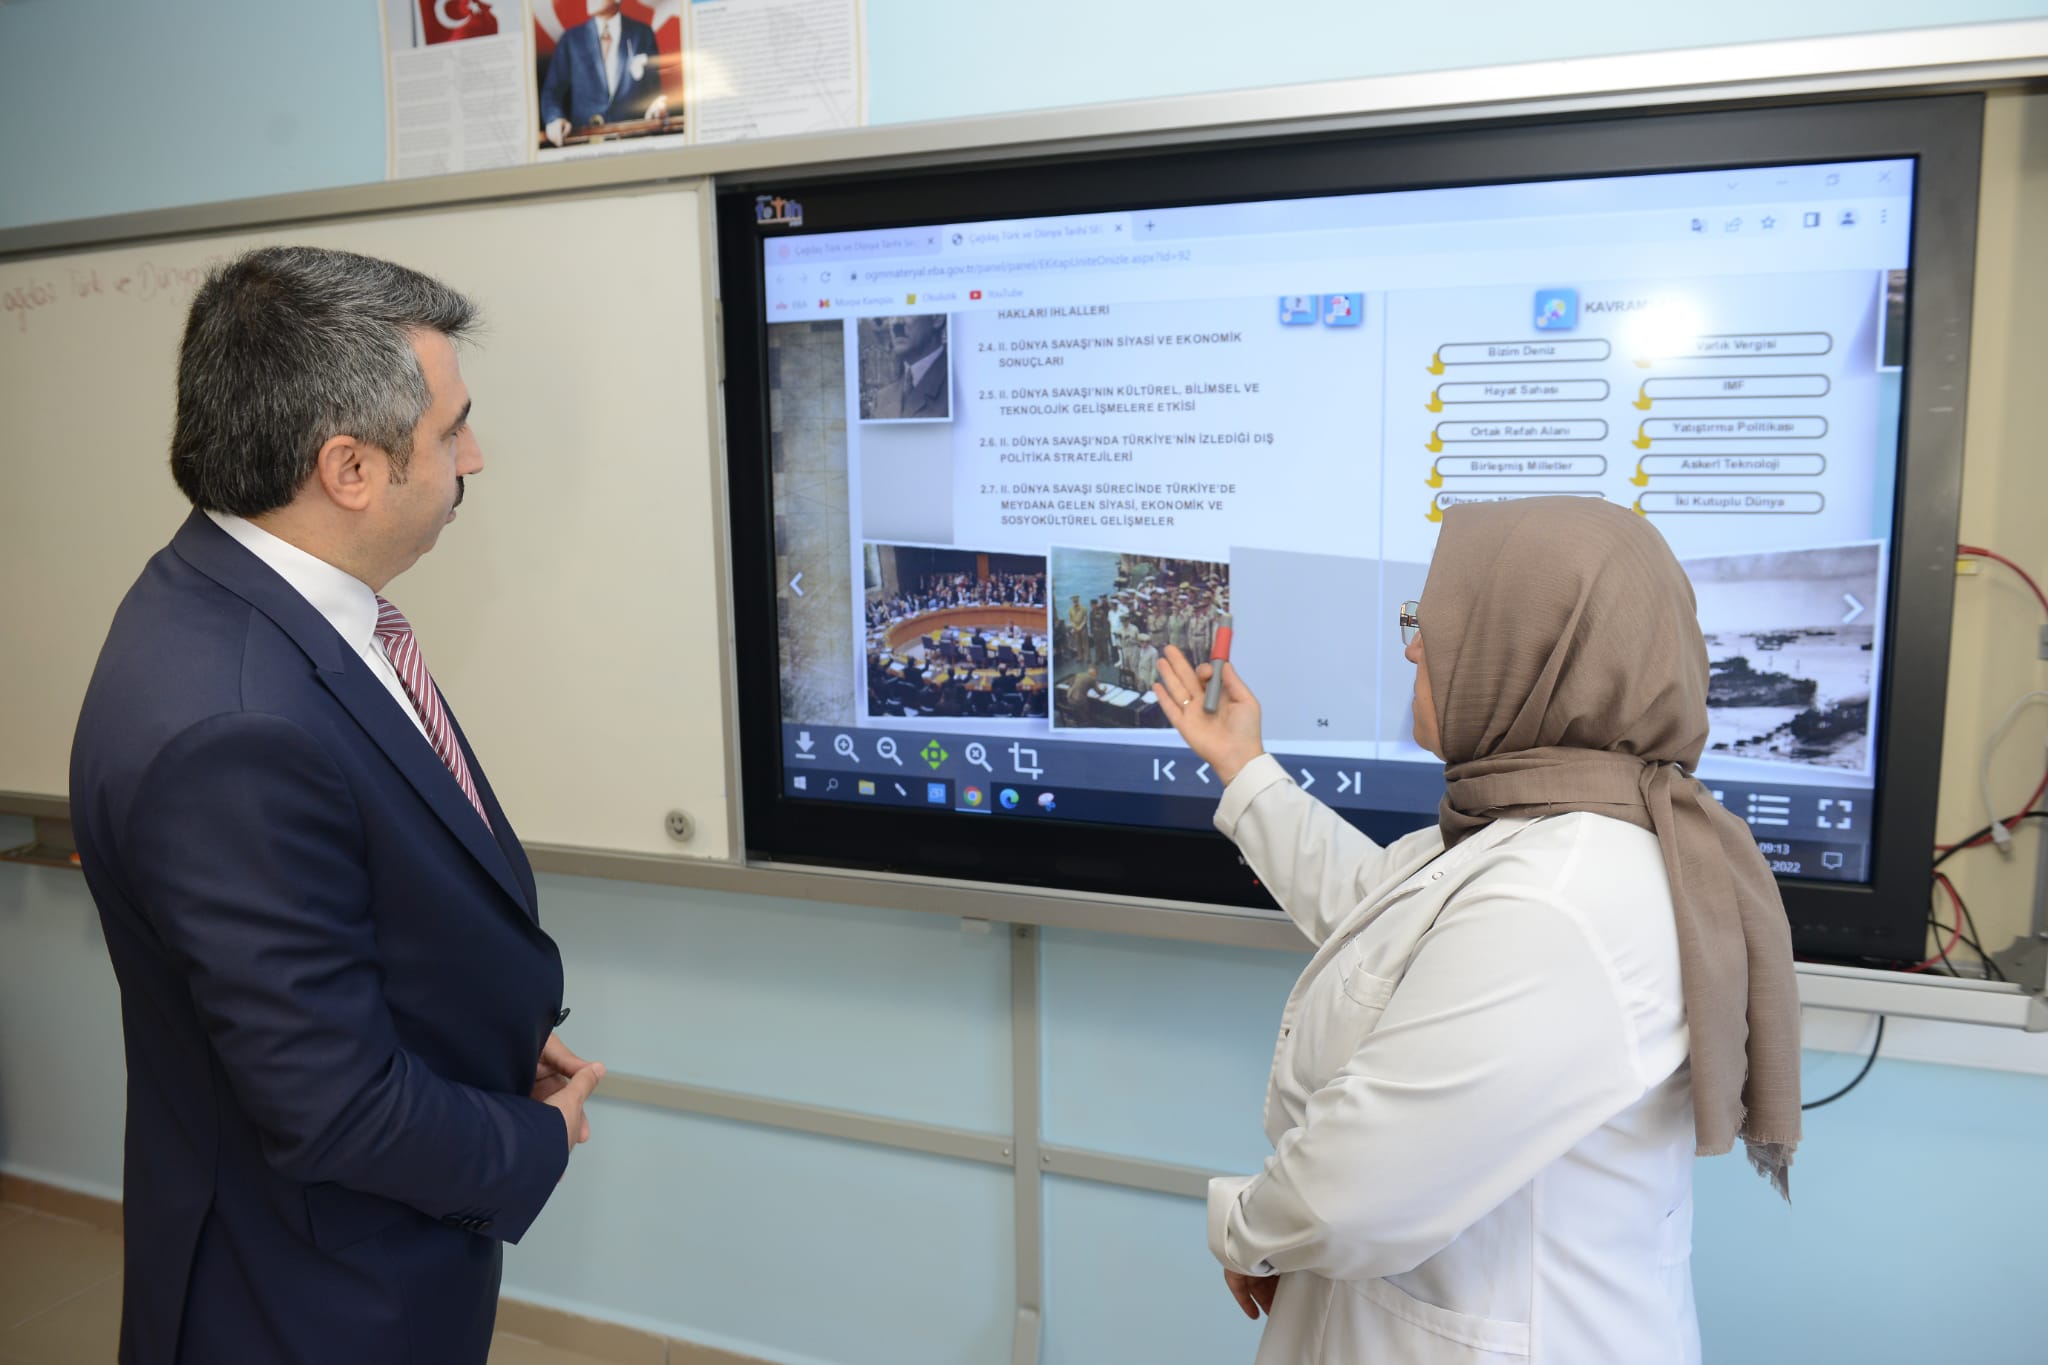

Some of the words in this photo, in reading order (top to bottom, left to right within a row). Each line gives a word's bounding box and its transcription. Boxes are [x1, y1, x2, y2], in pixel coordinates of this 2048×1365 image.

[998, 308, 1047, 320] HAKLARI
[978, 342, 996, 352] 2.4.
[998, 341, 1008, 351] II.
[1010, 339, 1048, 351] DÜNYA
[1051, 337, 1114, 350] SAVAŞI'NIN
[1117, 334, 1154, 347] SİYASİ
[1157, 335, 1173, 345] VE
[1176, 331, 1242, 345] EKONOMİK
[1488, 346, 1520, 357] Bizim
[1523, 345, 1556, 356] Deniz
[998, 356, 1064, 368] SONUÇLARI
[979, 389, 997, 400] 2.5.
[999, 389, 1009, 400] II.
[1011, 387, 1049, 399] DÜNYA
[1052, 386, 1114, 399] SAVAŞI'NIN
[1117, 384, 1182, 396] KÜLTÜREL,
[1185, 381, 1241, 394] BİLİMSEL
[1244, 382, 1260, 393] VE
[1484, 385, 1517, 397] Hayat
[1520, 384, 1559, 395] Sahası
[1000, 403, 1069, 416] TEKNOLOJİK
[1073, 402, 1154, 415] GELİŞMELERE
[1157, 400, 1196, 412] ETKİSİ
[1470, 426, 1501, 437] Ortak
[1504, 425, 1538, 436] Refah
[1540, 425, 1570, 436] Alanı
[1673, 422, 1734, 434] Yatıştırma
[1737, 421, 1794, 432] Politikası
[979, 437, 997, 448] 2.6.
[1000, 436, 1010, 447] II.
[1012, 435, 1049, 447] DÜNYA
[1052, 435, 1119, 448] SAVAŞI'NDA
[1122, 432, 1196, 446] TÜRKİYE'NİN
[1199, 431, 1250, 444] İZLEDİĞİ
[1253, 432, 1275, 445] DIŞ
[1000, 451, 1051, 463] POLİTİKA
[1053, 450, 1133, 463] STRATEJİLERİ
[1470, 461, 1524, 472] Birleşmiş
[1527, 460, 1573, 471] Milletler
[1724, 458, 1780, 471] Teknoloji
[980, 484, 998, 494] 2.7.
[1000, 484, 1010, 494] II.
[1012, 483, 1050, 494] DÜNYA
[1053, 483, 1092, 495] SAVAŞI
[1095, 482, 1161, 494] SÜRECİNDE
[1166, 482, 1236, 494] TÜRKİYE'DE
[1001, 500, 1054, 510] MEYDANA
[1057, 500, 1095, 510] GELEN
[1098, 499, 1137, 511] SİYASİ,
[1140, 498, 1204, 511] EKONOMİK
[1208, 500, 1223, 510] VE
[1675, 495, 1689, 506] İki
[1692, 496, 1742, 508] Kutuplu
[1745, 496, 1785, 508] Dünya
[1001, 513, 1097, 526] SOSYOKÜLTÜREL
[1100, 514, 1175, 527] GELİŞMELER
[1317, 718, 1329, 728] 54
[1759, 842, 1790, 855] 09:13
